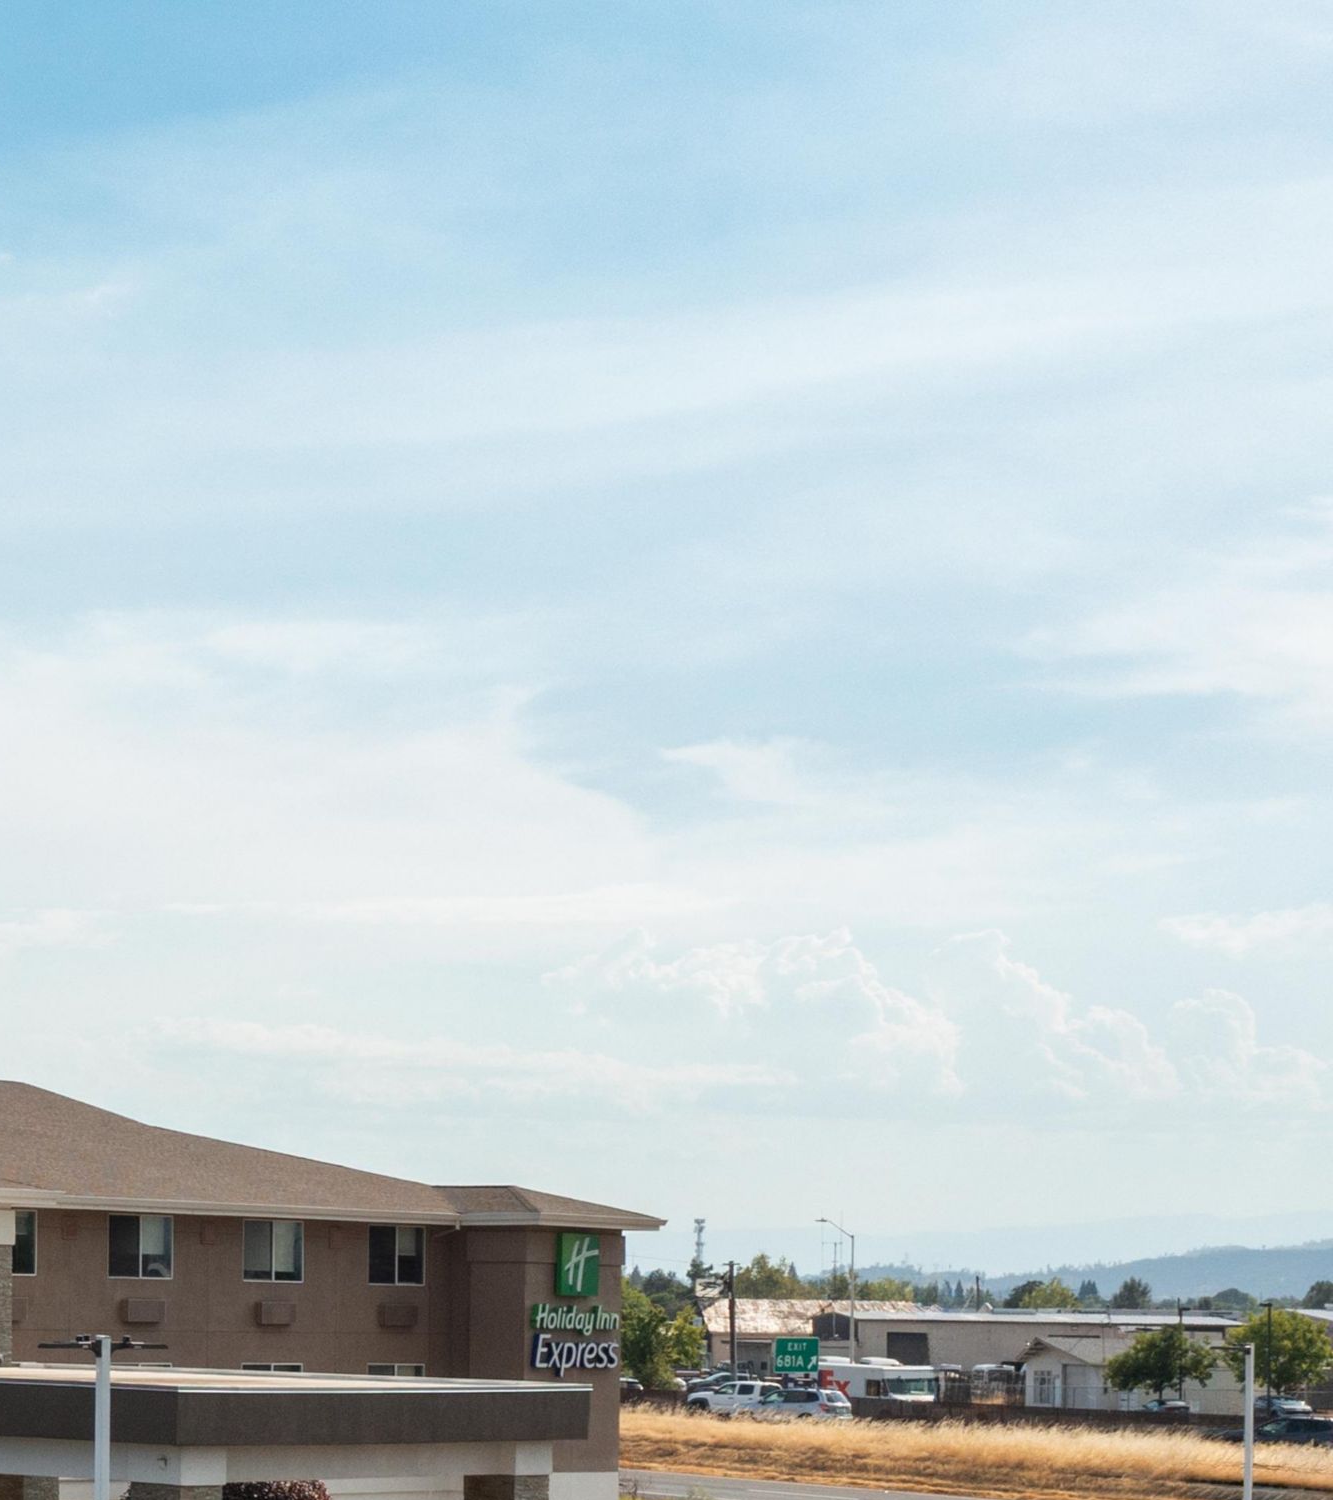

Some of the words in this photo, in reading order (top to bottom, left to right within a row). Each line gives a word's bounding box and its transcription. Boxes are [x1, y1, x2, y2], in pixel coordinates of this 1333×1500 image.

[536, 1303, 595, 1336] Holiday
[596, 1305, 619, 1330] Inn
[535, 1333, 619, 1378] Express
[787, 1342, 807, 1352] EXIT
[776, 1355, 804, 1368] 681A
